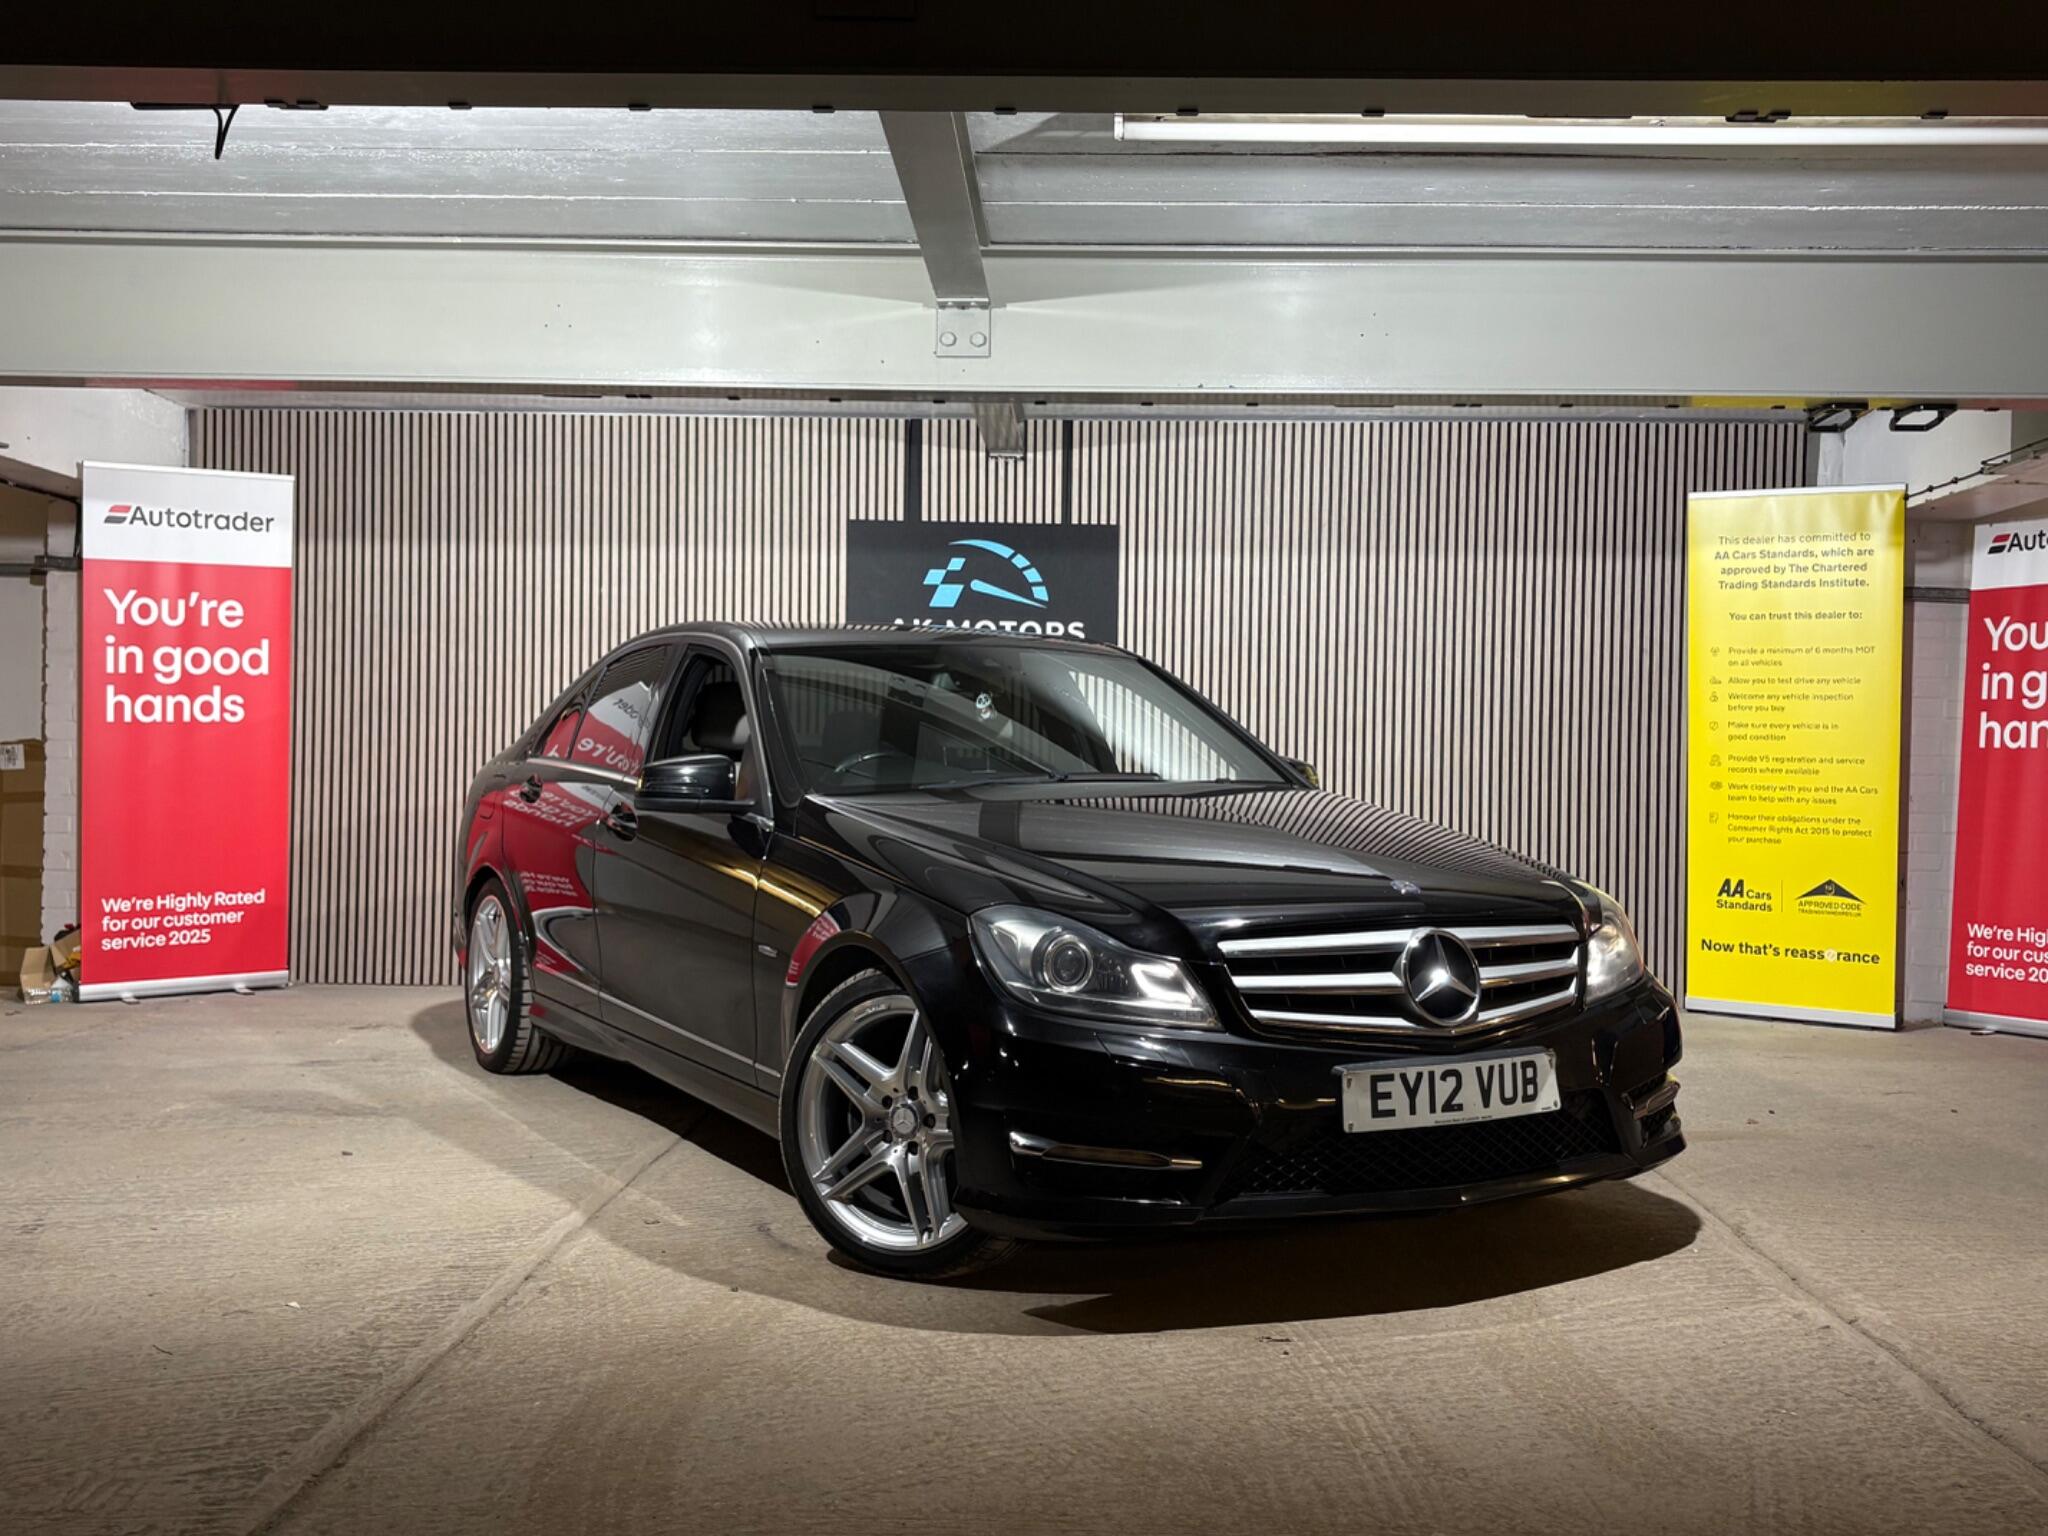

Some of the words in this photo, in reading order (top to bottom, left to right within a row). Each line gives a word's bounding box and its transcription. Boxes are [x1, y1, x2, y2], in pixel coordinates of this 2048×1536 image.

[129, 506, 274, 532] Autotrader
[1719, 536, 1740, 545] This
[1743, 535, 1774, 544] dealer
[1778, 534, 1795, 543] has
[1799, 532, 1856, 543] committed
[1860, 533, 1870, 541] to
[2007, 529, 2048, 553] Aut
[1715, 552, 1729, 560] AA
[1732, 550, 1756, 560] Cars
[1760, 550, 1818, 559] Standards,
[1822, 548, 1853, 557] which
[1720, 565, 1770, 576] approved
[1774, 564, 1786, 574] by
[1788, 563, 1809, 573] The
[1812, 562, 1868, 573] Chartered
[1718, 580, 1758, 591] Trading
[1761, 578, 1816, 589] Standards
[1819, 578, 1869, 587] Institute.
[104, 589, 244, 628] You're
[1729, 612, 1747, 621] You
[1749, 612, 1766, 620] can
[1769, 612, 1791, 620] trust
[1795, 611, 1812, 620] this
[1815, 610, 1846, 619] dealer
[1849, 610, 1862, 619] to:
[1815, 646, 1820, 654] 6
[1822, 646, 1853, 654] months
[1856, 646, 1875, 654] MOT
[105, 635, 143, 674] in
[153, 638, 269, 684] good
[1752, 678, 1765, 686] you
[1817, 678, 1830, 686] any
[1981, 662, 2014, 700] in
[106, 684, 245, 723] hands
[1767, 694, 1780, 702] any
[1782, 692, 1810, 700] vehicle
[1813, 693, 1853, 702] inspection
[1755, 705, 1768, 713] you
[1771, 705, 1785, 713] buy
[1769, 723, 1790, 731] every
[1792, 722, 1820, 730] vehicle
[1728, 733, 1747, 742] good
[1728, 755, 1757, 763] Provide
[1772, 756, 1816, 765] registration
[1728, 766, 1757, 774] records
[1728, 782, 1748, 790] Work
[1751, 783, 1776, 793] closely
[1777, 784, 1796, 792] with
[1798, 786, 1811, 794] you
[1845, 786, 1857, 794] AA
[1759, 795, 1775, 803] help
[1796, 798, 1810, 806] any
[1812, 797, 1836, 805] issues
[1777, 815, 1820, 824] obligations
[1728, 824, 1767, 832] Consumer
[1769, 825, 1793, 835] Rights
[1795, 827, 1808, 835] Act
[1833, 828, 1840, 836] to
[1842, 829, 1872, 838] protect
[1746, 837, 1781, 845] purchase
[1718, 878, 1744, 898] AA
[1746, 889, 1772, 900] Cars
[101, 897, 154, 913] We're
[157, 892, 212, 912] Highly
[214, 888, 265, 906] Rated
[1716, 899, 1772, 912] Standards
[1840, 902, 1862, 911] CODE
[101, 916, 129, 932] for
[132, 915, 161, 930] our
[163, 910, 244, 928] customer
[1967, 922, 2014, 941] We're
[101, 933, 166, 951] service
[169, 928, 211, 945] 2025
[1701, 939, 1734, 952] Now
[1739, 942, 1780, 956] that's
[1967, 941, 1990, 957] for
[1992, 947, 2020, 961] our
[1966, 963, 2025, 980] service
[1370, 1069, 1463, 1119] EY12
[1475, 1060, 1538, 1109] VUB
